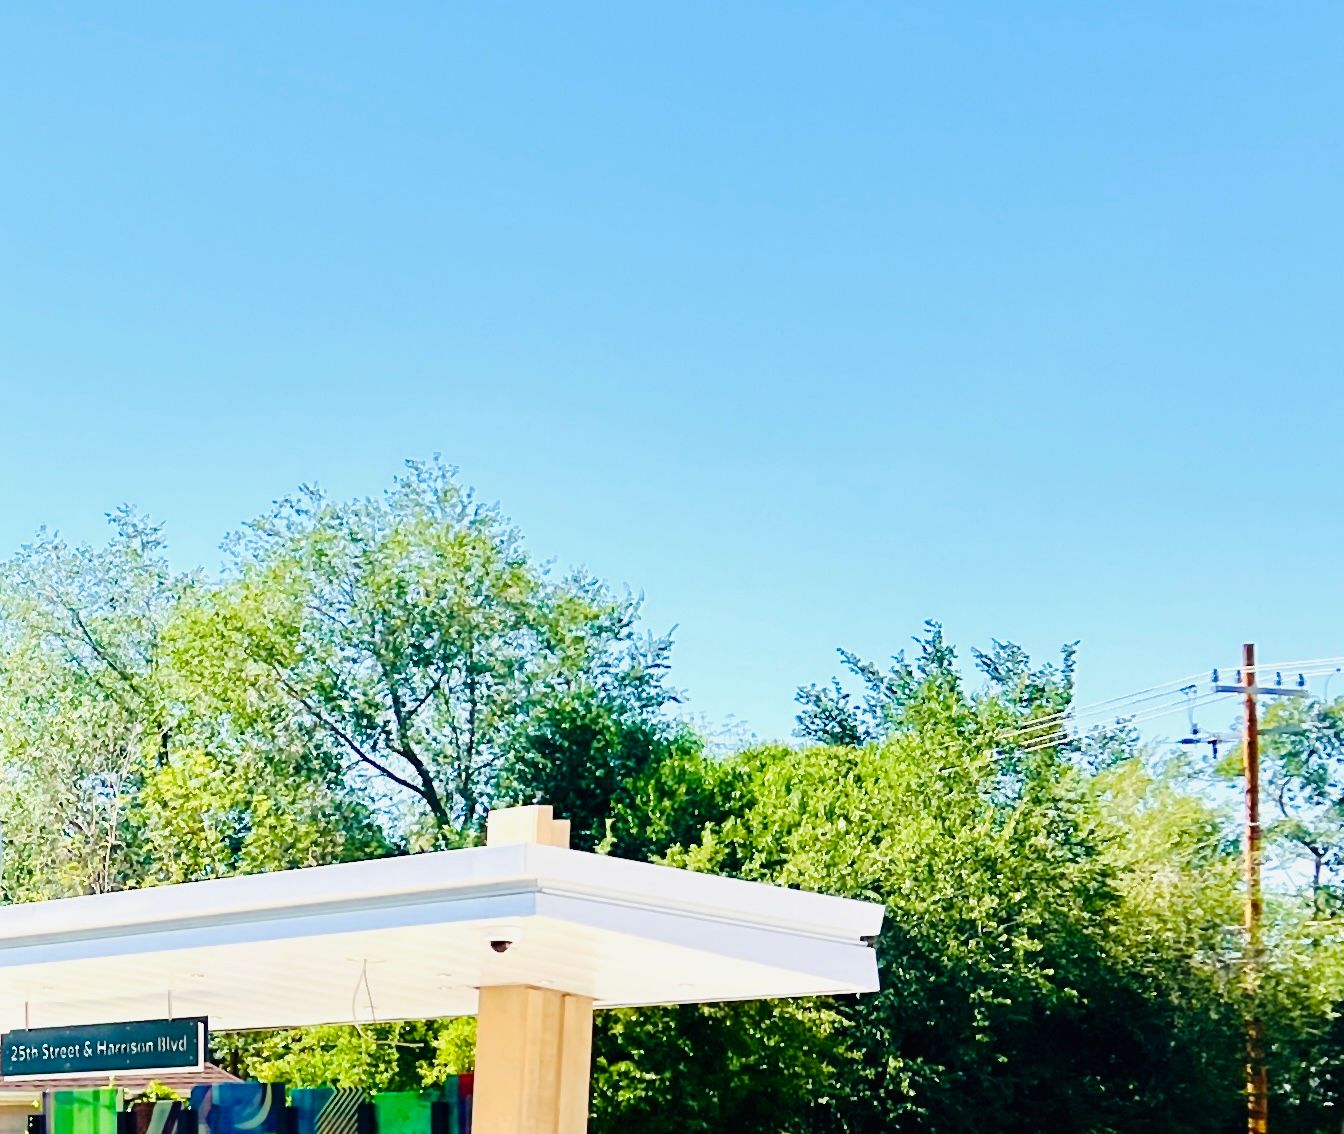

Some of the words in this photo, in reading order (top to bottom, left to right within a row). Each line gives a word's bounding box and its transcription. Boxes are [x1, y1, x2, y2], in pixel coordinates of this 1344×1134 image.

[11, 1046, 39, 1061] 25th
[42, 1042, 80, 1060] Street
[83, 1041, 93, 1057] &
[96, 1039, 154, 1055] Harrison
[157, 1035, 187, 1052] Blvd
